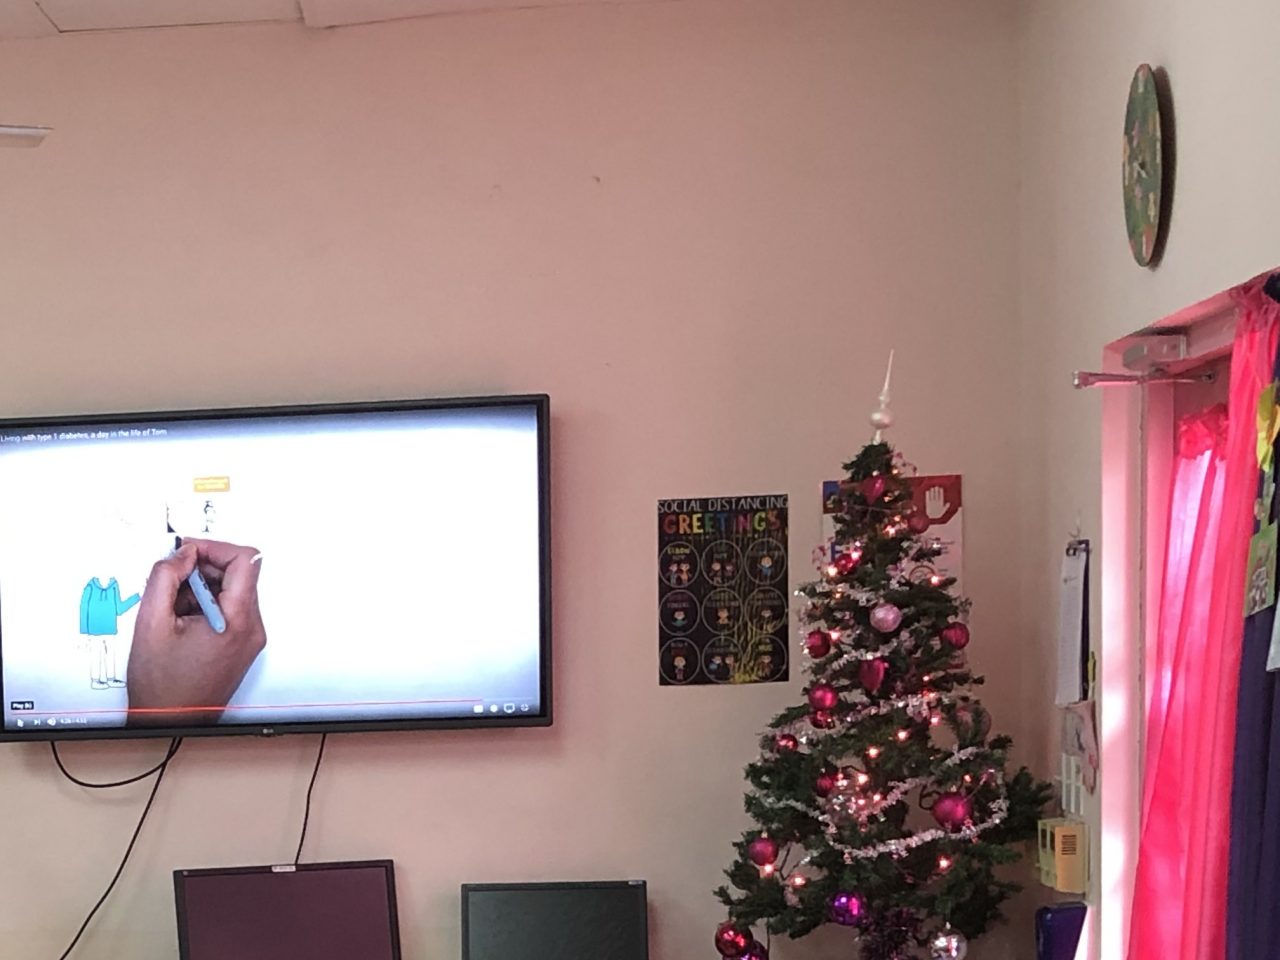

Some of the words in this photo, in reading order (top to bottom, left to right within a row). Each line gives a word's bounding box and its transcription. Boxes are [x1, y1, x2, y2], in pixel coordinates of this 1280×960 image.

[37, 433, 51, 442] type
[96, 430, 109, 439] day
[118, 429, 129, 437] the
[130, 428, 141, 437] life
[142, 428, 150, 436] of
[657, 500, 702, 513] SOCIAL
[708, 495, 788, 511] DISTANCING
